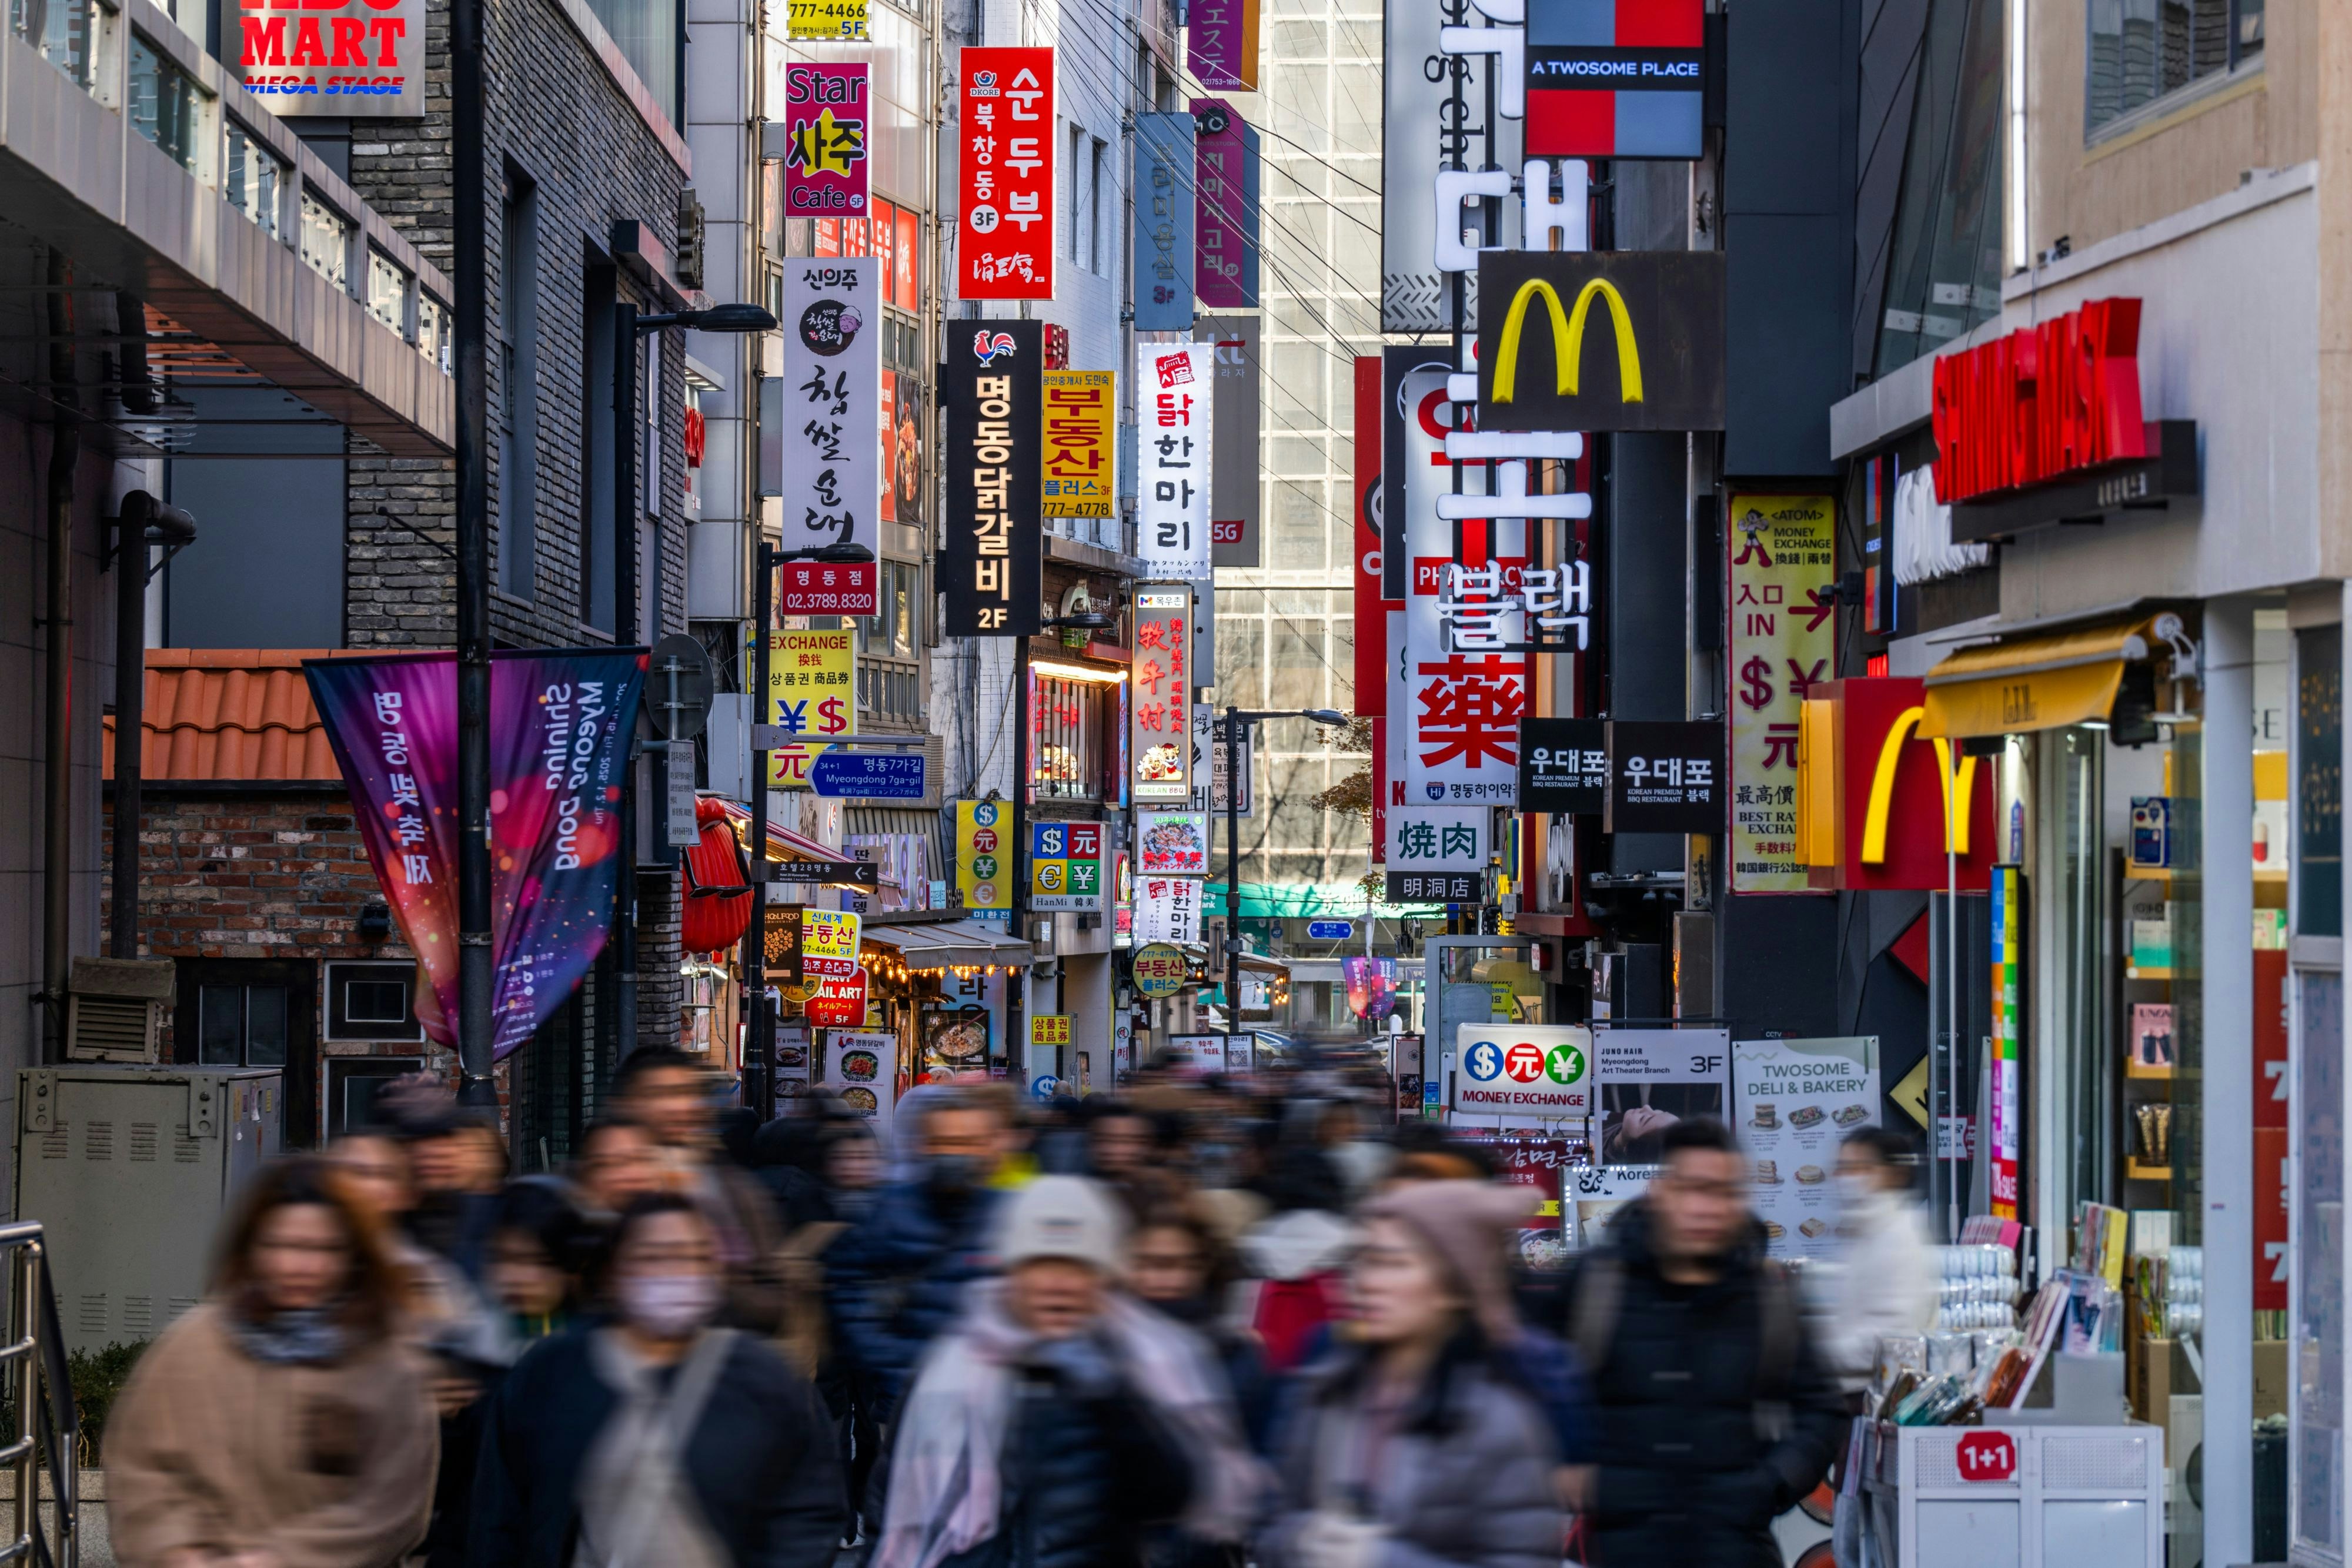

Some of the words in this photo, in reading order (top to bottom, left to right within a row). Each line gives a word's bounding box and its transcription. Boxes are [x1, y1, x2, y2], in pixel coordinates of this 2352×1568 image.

[790, 2, 865, 17] 777-4466
[841, 21, 864, 35] 5F
[240, 17, 406, 67] MART
[1532, 62, 1545, 74] A
[1548, 62, 1637, 75] TWOSOME
[1642, 63, 1699, 76] PLACE
[242, 76, 318, 94] MEGA
[325, 76, 405, 95] STAGE
[787, 69, 866, 103] Star
[787, 119, 866, 170] 사주
[973, 103, 997, 200] 북창동
[1005, 68, 1043, 232] 순두부
[791, 185, 846, 208] Cafe
[851, 198, 863, 206] 5F
[975, 212, 995, 226] 3F
[1204, 152, 1224, 276] 치마저고리
[1227, 265, 1237, 274] 3F
[803, 269, 858, 291] 신의주
[1153, 286, 1175, 305] 3F
[1492, 278, 1644, 404] M
[1043, 376, 1082, 386] 공인중개사
[1085, 375, 1109, 386] 도민숙
[1161, 367, 1192, 385] 시골
[1045, 389, 1105, 477] 부동산
[799, 365, 855, 544] 찹쌀순대
[1154, 393, 1195, 551] 닭한마리
[973, 375, 1014, 601] 명동닭갈비
[1044, 480, 1098, 496] 플러스
[1101, 485, 1111, 496] 3F
[1043, 503, 1110, 516] 777-4778
[1214, 523, 1237, 540] 5G
[1773, 527, 1815, 537] MONEY
[1773, 539, 1831, 549] EXCHANGE
[797, 570, 863, 586] 명동점
[787, 593, 872, 610] 02.3789.8320
[1156, 597, 1182, 606] 목우촌
[1736, 584, 1783, 606] 入口
[1434, 560, 1589, 650] 블랙
[978, 608, 1008, 628] 2F
[1747, 614, 1775, 636] IN
[770, 636, 847, 650] EXCHANGE
[770, 673, 809, 686] 상품권
[814, 672, 849, 685] 商品券
[1138, 621, 1170, 731] 牧牛村
[1740, 656, 1773, 711] $
[777, 699, 808, 734] ¥
[817, 696, 847, 735] $
[1418, 654, 1525, 768] 藥
[774, 745, 810, 779] 元
[864, 758, 921, 773] 명동7가길
[1529, 748, 1605, 774] 우대포
[826, 775, 886, 787] Myeongdong
[888, 775, 921, 787] 7ga-gil
[1623, 757, 1713, 787] 우대포
[1450, 783, 1516, 798] 명동하이약
[1583, 776, 1602, 787] 블랙
[1430, 788, 1441, 797] Hi
[1686, 789, 1709, 802] 블랙
[1735, 785, 1794, 806] 最高價
[979, 805, 993, 824] $
[1739, 812, 1772, 821] BEST
[977, 833, 994, 851] 元
[1041, 828, 1063, 855] $
[1074, 831, 1097, 854] 元
[1398, 821, 1476, 860] 焼肉
[977, 859, 994, 877] ¥
[1038, 865, 1061, 890] €
[1073, 865, 1094, 890] ¥
[975, 885, 993, 904] €
[1151, 888, 1168, 897] 시골
[1403, 878, 1469, 897] 明洞店
[1075, 897, 1094, 907] 韓美
[1171, 881, 1192, 940] 닭한마리
[812, 912, 842, 924] 신세계
[802, 924, 855, 946] 부동산
[802, 945, 837, 954] 77-4466
[803, 959, 821, 971] 의주
[824, 961, 852, 974] 순대국
[1135, 959, 1184, 977] 부동산
[816, 986, 837, 998] AIL
[838, 987, 863, 999] ART
[1142, 979, 1178, 991] 플러스
[817, 1002, 853, 1011] ネイルアート
[836, 1015, 848, 1023] 5F
[1034, 1018, 1068, 1029] 상품권
[856, 1039, 885, 1048] 명동닭갈비
[1034, 1031, 1068, 1042] 商品券
[1474, 1044, 1496, 1079] $
[1511, 1048, 1540, 1078] 元
[1553, 1051, 1577, 1081] ¥
[1601, 1058, 1649, 1067] Myeongdong
[1689, 1056, 1723, 1074] 3F
[1762, 1062, 1850, 1078] TWOSOME
[1748, 1082, 1783, 1095] DELI
[1788, 1082, 1798, 1094] &
[1803, 1079, 1867, 1094] BAKERY
[1462, 1090, 1511, 1104] MONEY
[1514, 1092, 1584, 1106] EXCHANGE
[1963, 1445, 2009, 1470] 1+1
